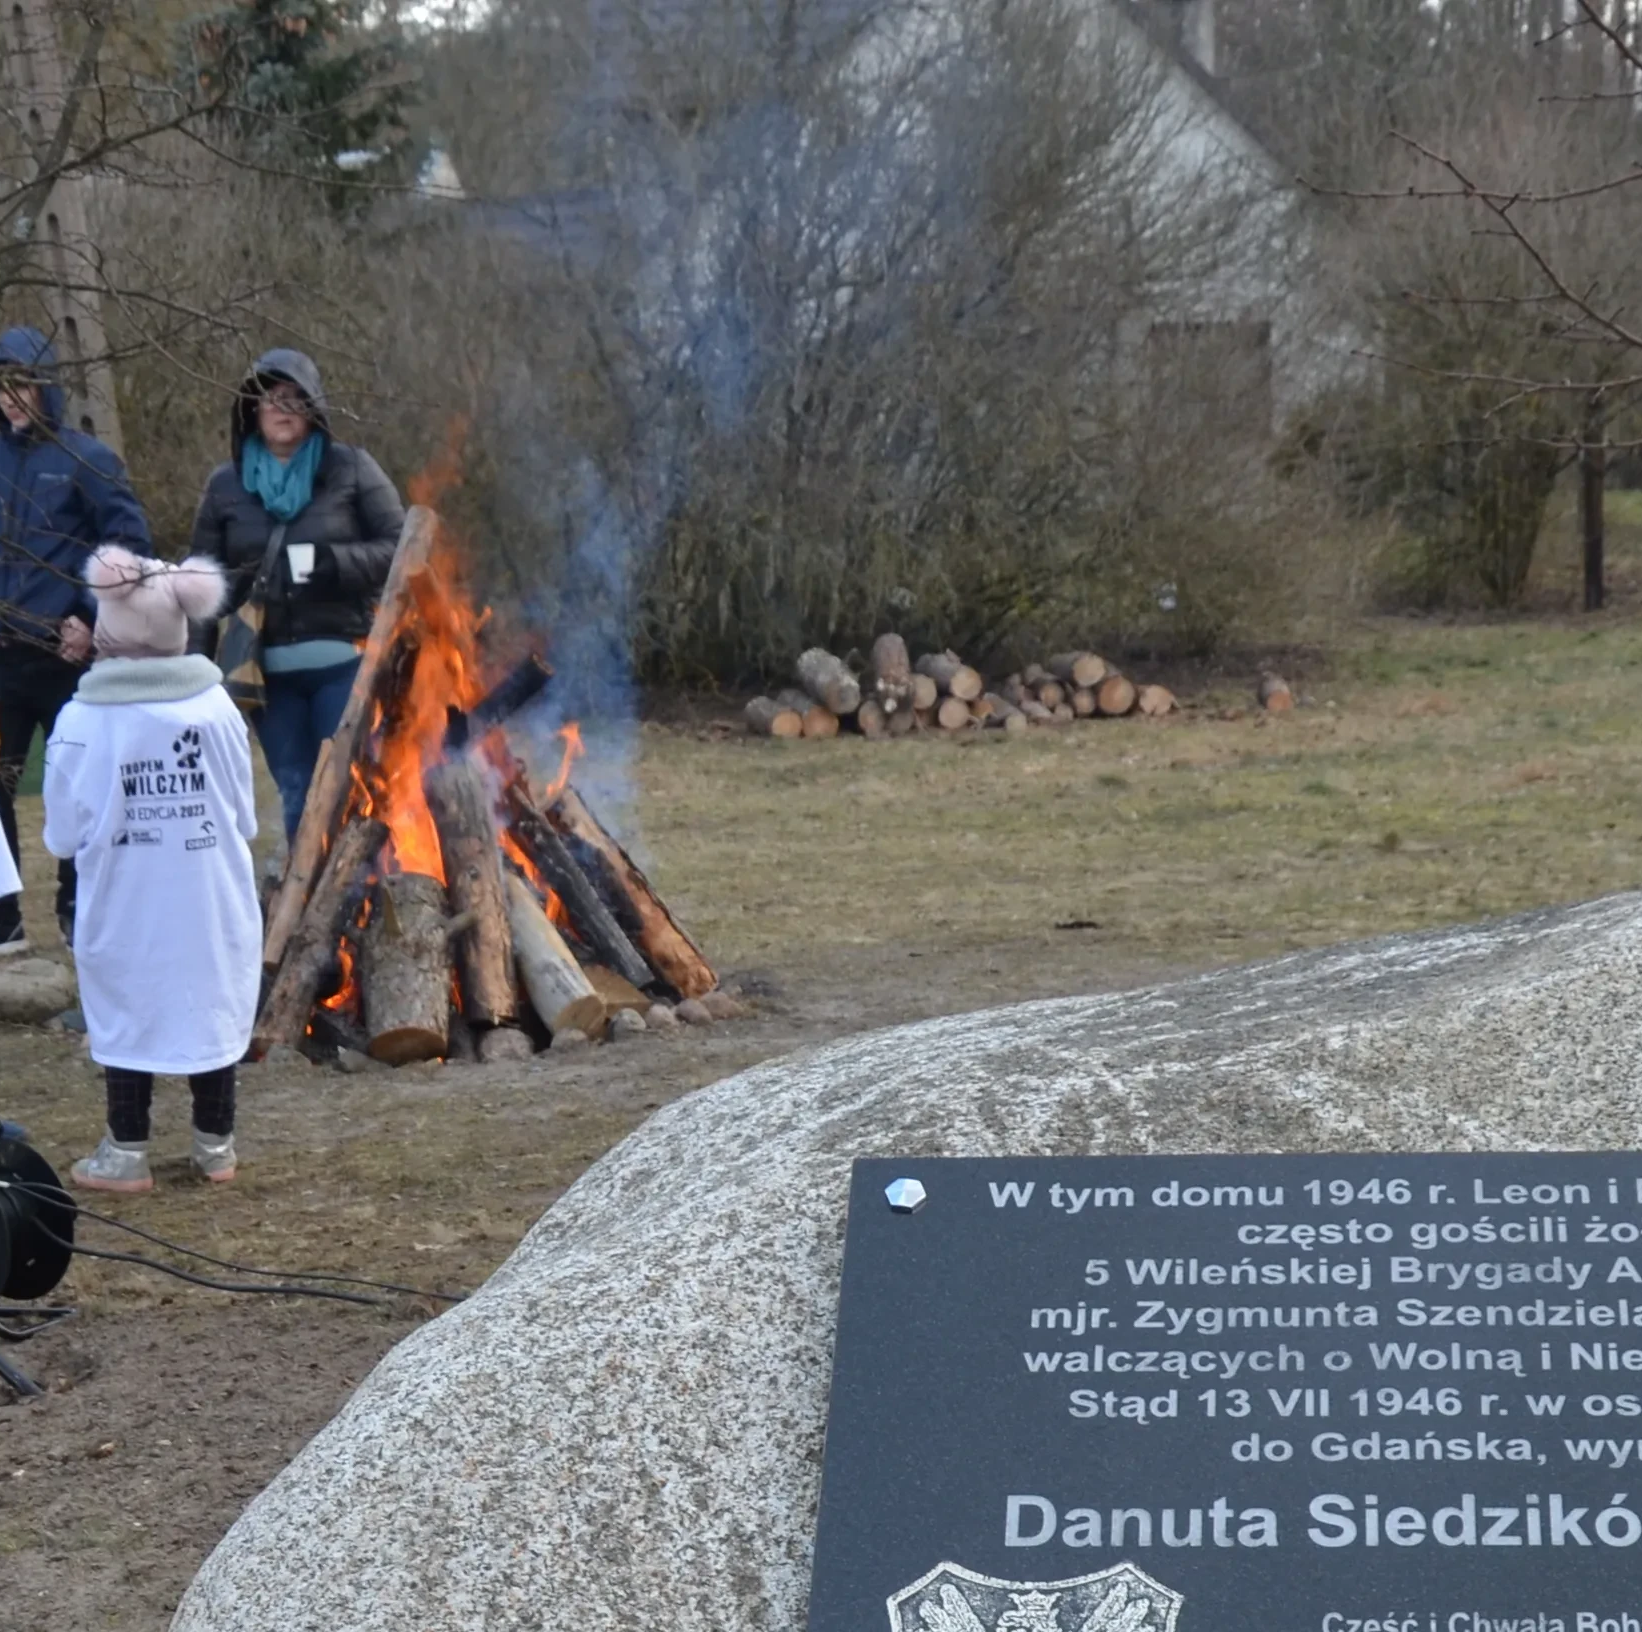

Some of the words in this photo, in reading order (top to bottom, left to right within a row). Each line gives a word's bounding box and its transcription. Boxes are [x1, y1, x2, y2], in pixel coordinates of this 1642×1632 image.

[119, 759, 165, 777] TROPEM
[121, 771, 206, 798] WILCZYM
[137, 806, 179, 821] EDYCJA
[179, 803, 206, 819] 2023
[987, 1181, 1037, 1209] W
[1047, 1181, 1135, 1215] tym
[1151, 1179, 1285, 1208] domu
[1302, 1177, 1413, 1207] 1946
[1428, 1184, 1457, 1205] r.
[1472, 1177, 1591, 1205] Leon
[1607, 1177, 1620, 1205] i
[1236, 1217, 1394, 1252] często
[1409, 1215, 1569, 1251] gościli
[1084, 1258, 1111, 1287] 5
[1124, 1256, 1372, 1292] Wileńskiej
[1389, 1255, 1594, 1291] Brygady
[1030, 1300, 1118, 1337] mjr.
[1132, 1300, 1380, 1336] Zygmunta
[1022, 1343, 1306, 1380] walczących
[1322, 1349, 1354, 1373] o
[1367, 1341, 1528, 1378] Wolną
[1540, 1341, 1552, 1371] i
[1067, 1388, 1179, 1426] Stąd
[1197, 1388, 1252, 1418] 13
[1266, 1387, 1330, 1418] VII
[1348, 1386, 1463, 1417] 1946
[1479, 1393, 1509, 1416] r.
[1524, 1394, 1567, 1417] w
[1230, 1432, 1294, 1463] do
[1310, 1430, 1547, 1466] Gdańska,
[1003, 1494, 1280, 1548] Danuta
